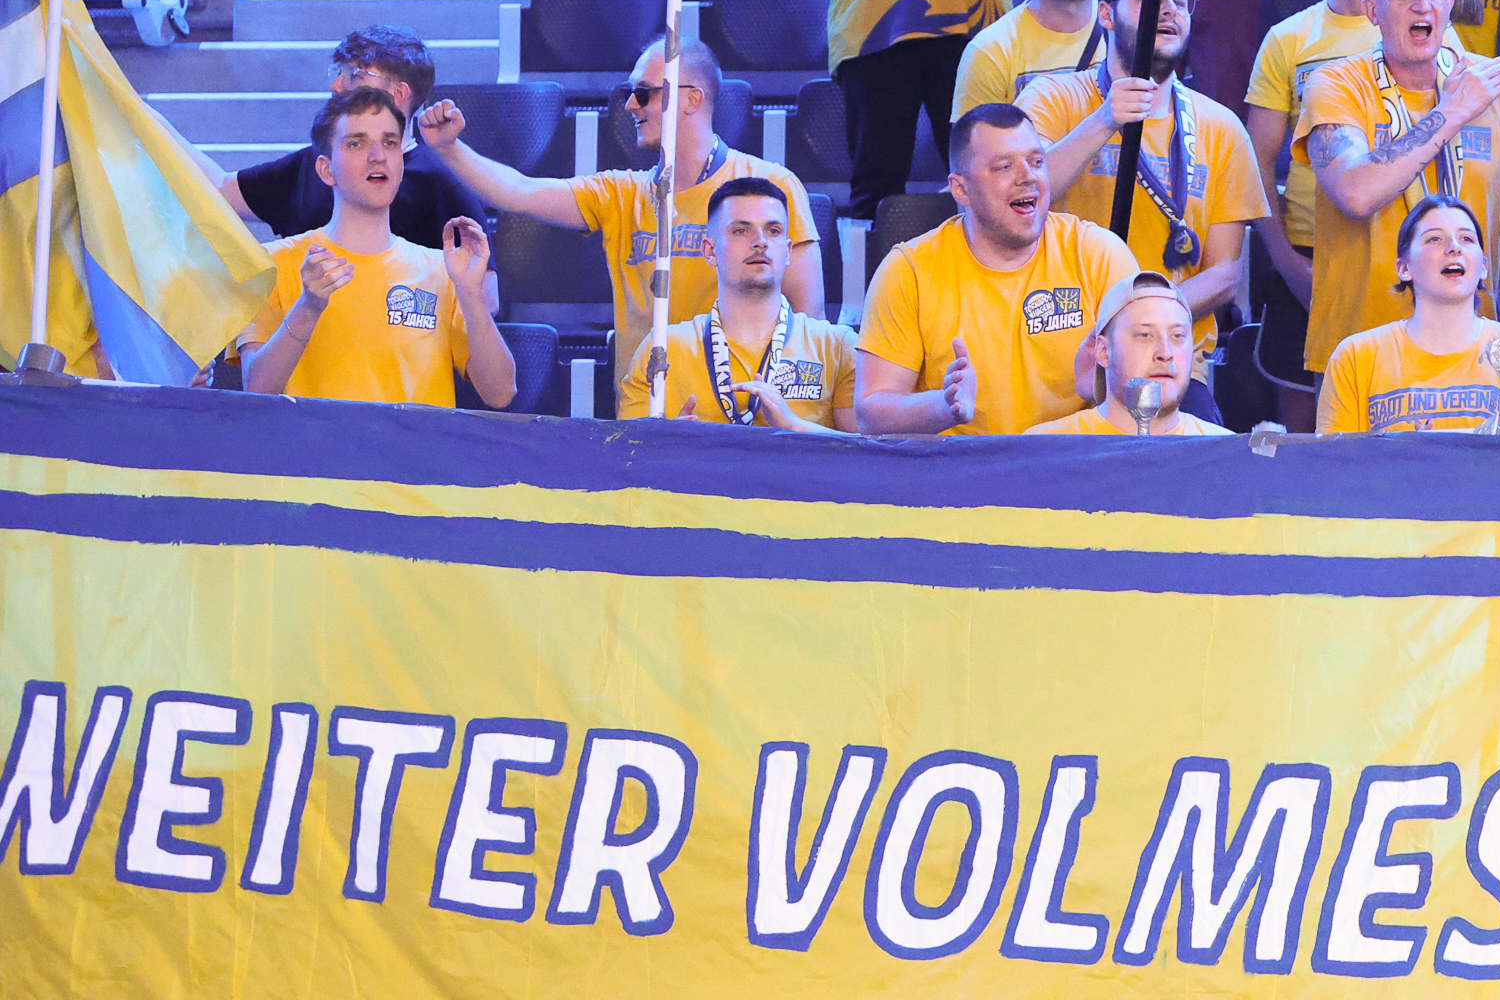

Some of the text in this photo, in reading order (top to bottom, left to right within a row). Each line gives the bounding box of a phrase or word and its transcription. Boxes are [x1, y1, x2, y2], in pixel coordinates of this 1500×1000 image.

[388, 310, 437, 330] 15 JAHRE
[1027, 309, 1084, 335] 15 JAHRE
[782, 384, 822, 400] JAHRE
[1368, 390, 1492, 425] STADT UND VEREIN
[0, 678, 698, 936] WEITER
